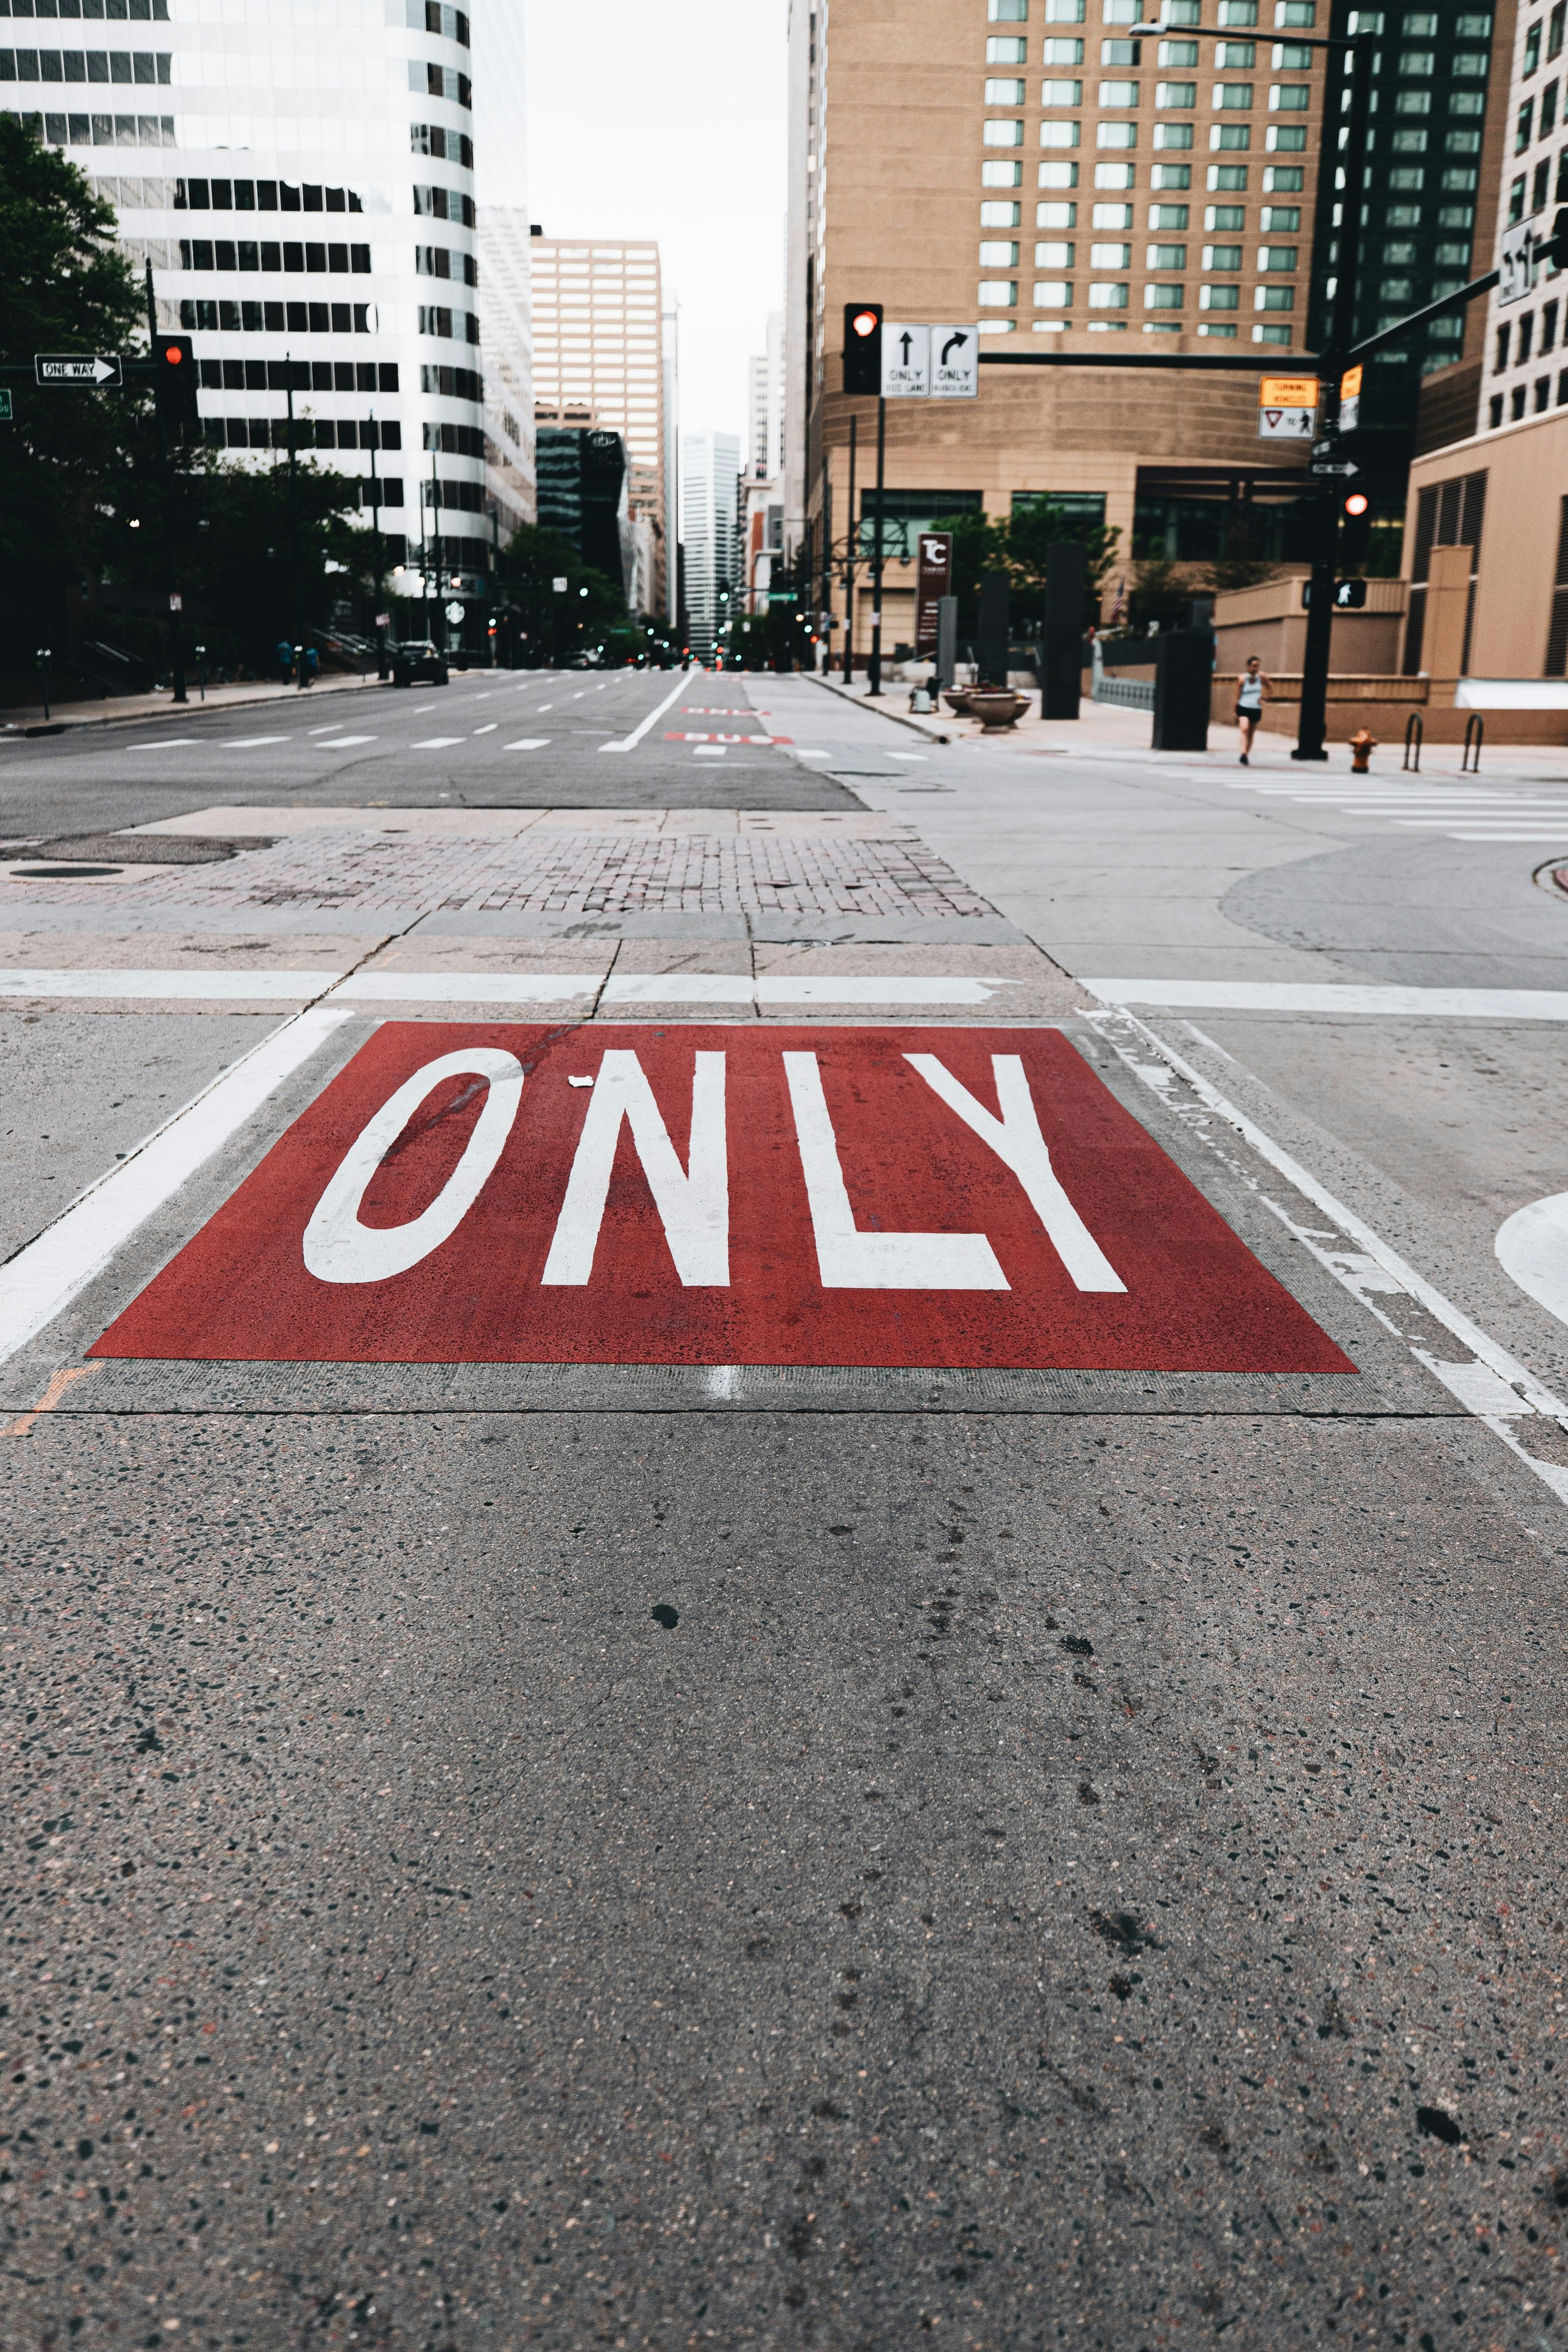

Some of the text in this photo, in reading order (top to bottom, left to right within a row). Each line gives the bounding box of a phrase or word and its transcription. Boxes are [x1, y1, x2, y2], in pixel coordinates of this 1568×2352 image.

[46, 363, 94, 376] ONE WAY
[890, 369, 922, 381] ONLY
[938, 369, 971, 381] ONLY
[906, 384, 925, 392] LANE
[1275, 383, 1307, 391] TURNING
[1273, 395, 1307, 404] VEHICLES
[922, 540, 946, 564] TC
[303, 1048, 1128, 1292] ONLY
